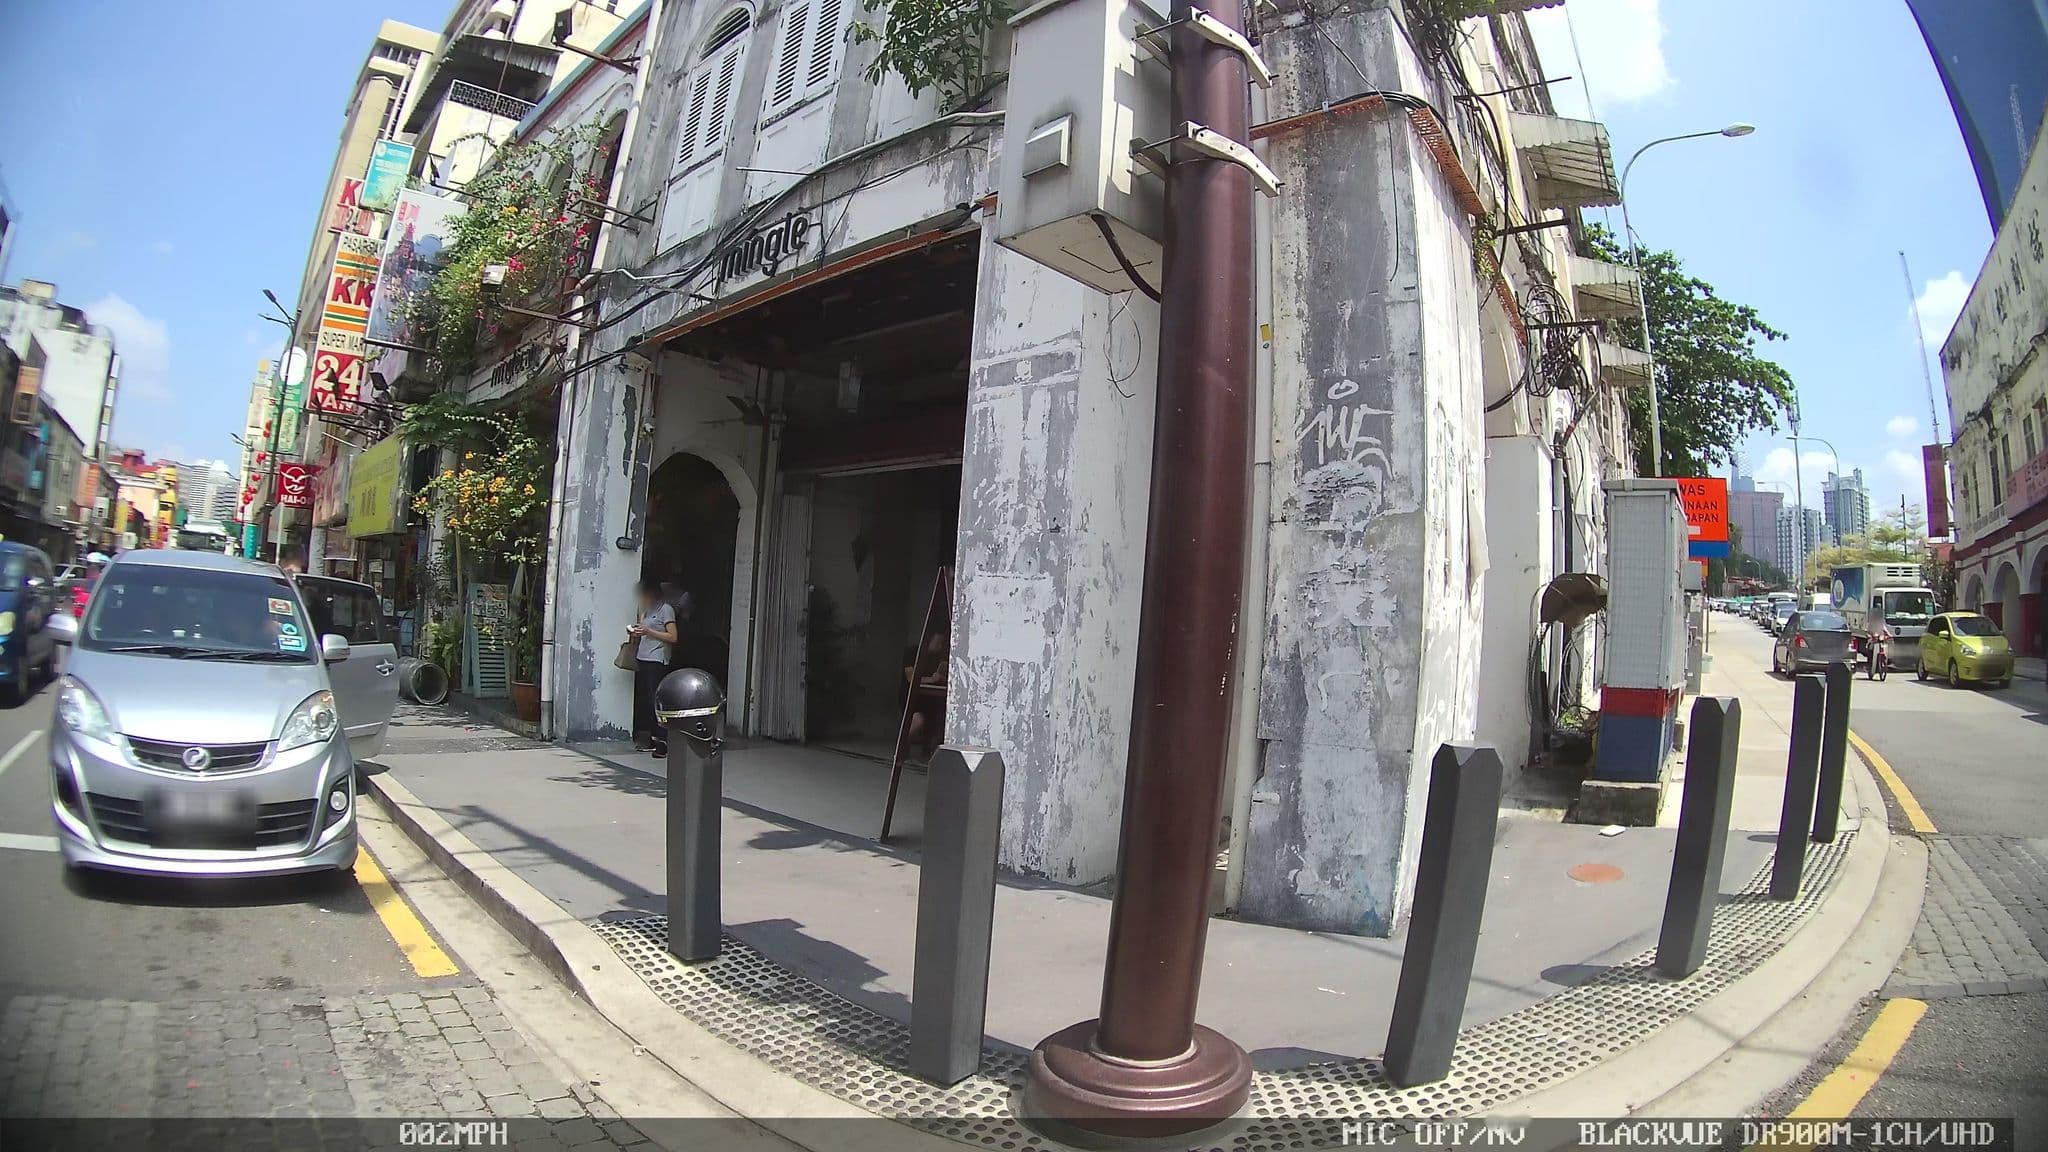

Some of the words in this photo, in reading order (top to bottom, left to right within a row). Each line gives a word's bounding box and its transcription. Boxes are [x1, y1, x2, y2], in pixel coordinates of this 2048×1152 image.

[720, 212, 809, 282] mingle
[331, 277, 376, 307] KK
[314, 354, 361, 395] 24
